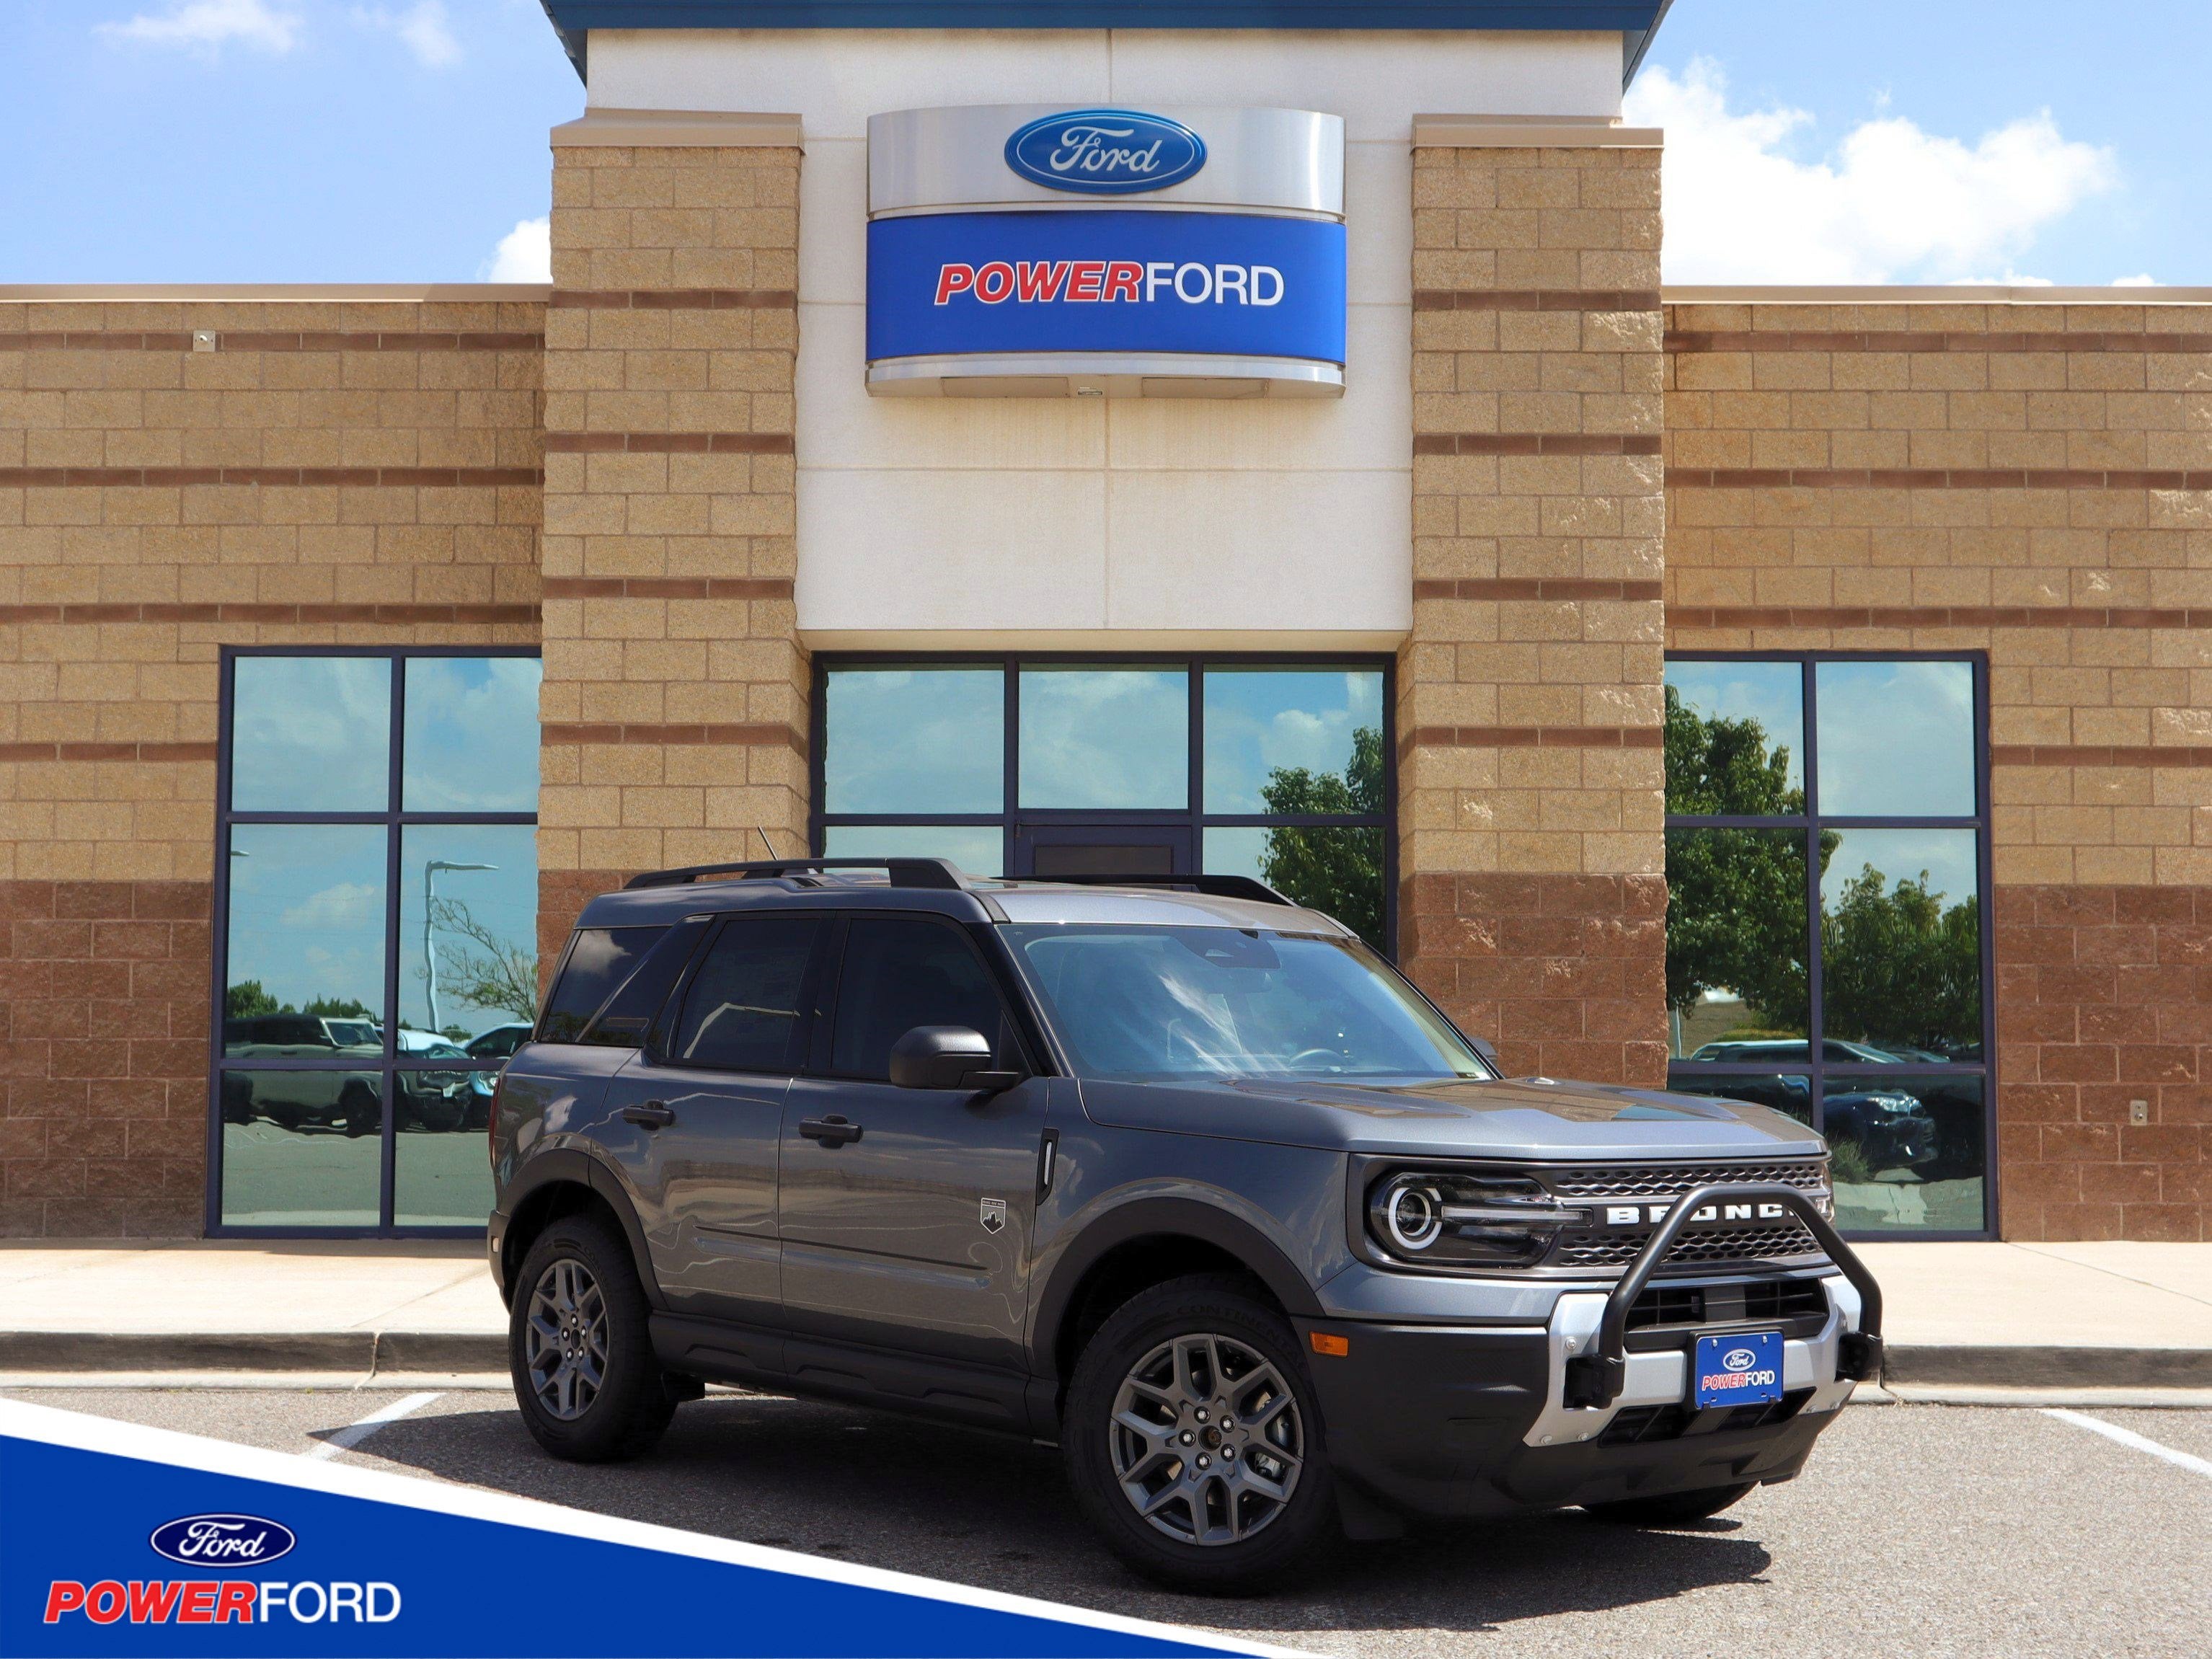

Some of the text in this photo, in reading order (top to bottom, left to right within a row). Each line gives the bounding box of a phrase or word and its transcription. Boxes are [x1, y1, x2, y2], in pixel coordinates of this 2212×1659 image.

[1050, 125, 1162, 174] Ford
[1606, 1203, 1795, 1225] BRONC
[1729, 1353, 1749, 1366] Ford
